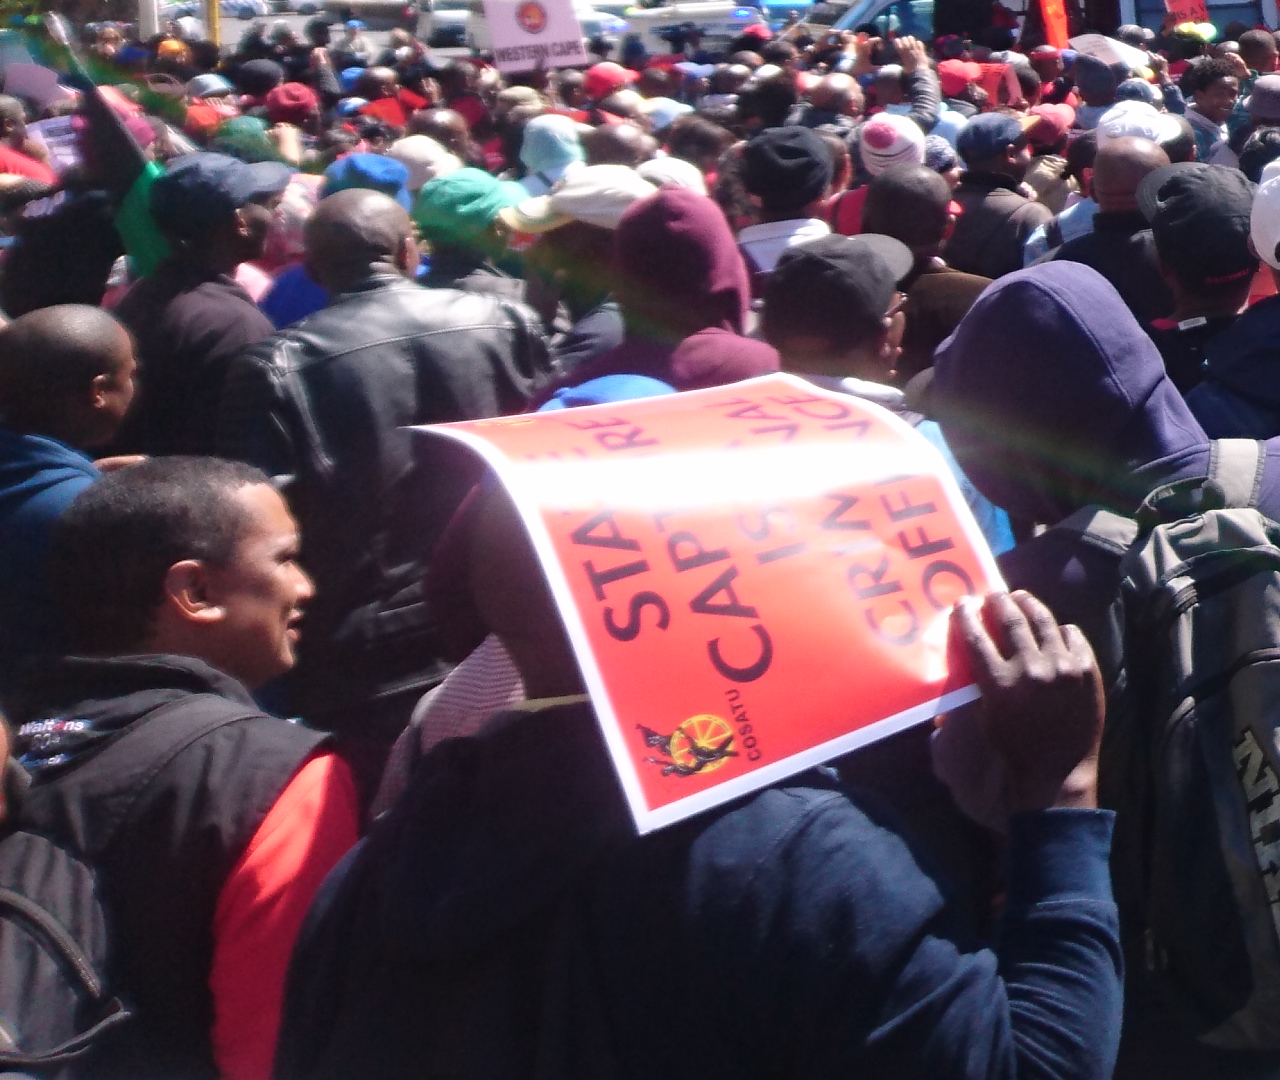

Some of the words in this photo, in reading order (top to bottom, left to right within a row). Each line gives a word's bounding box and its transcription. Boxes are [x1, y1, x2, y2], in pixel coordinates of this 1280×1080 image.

[496, 44, 549, 62] WESTERN
[551, 40, 581, 57] CAPE
[724, 688, 762, 762] COSATU
